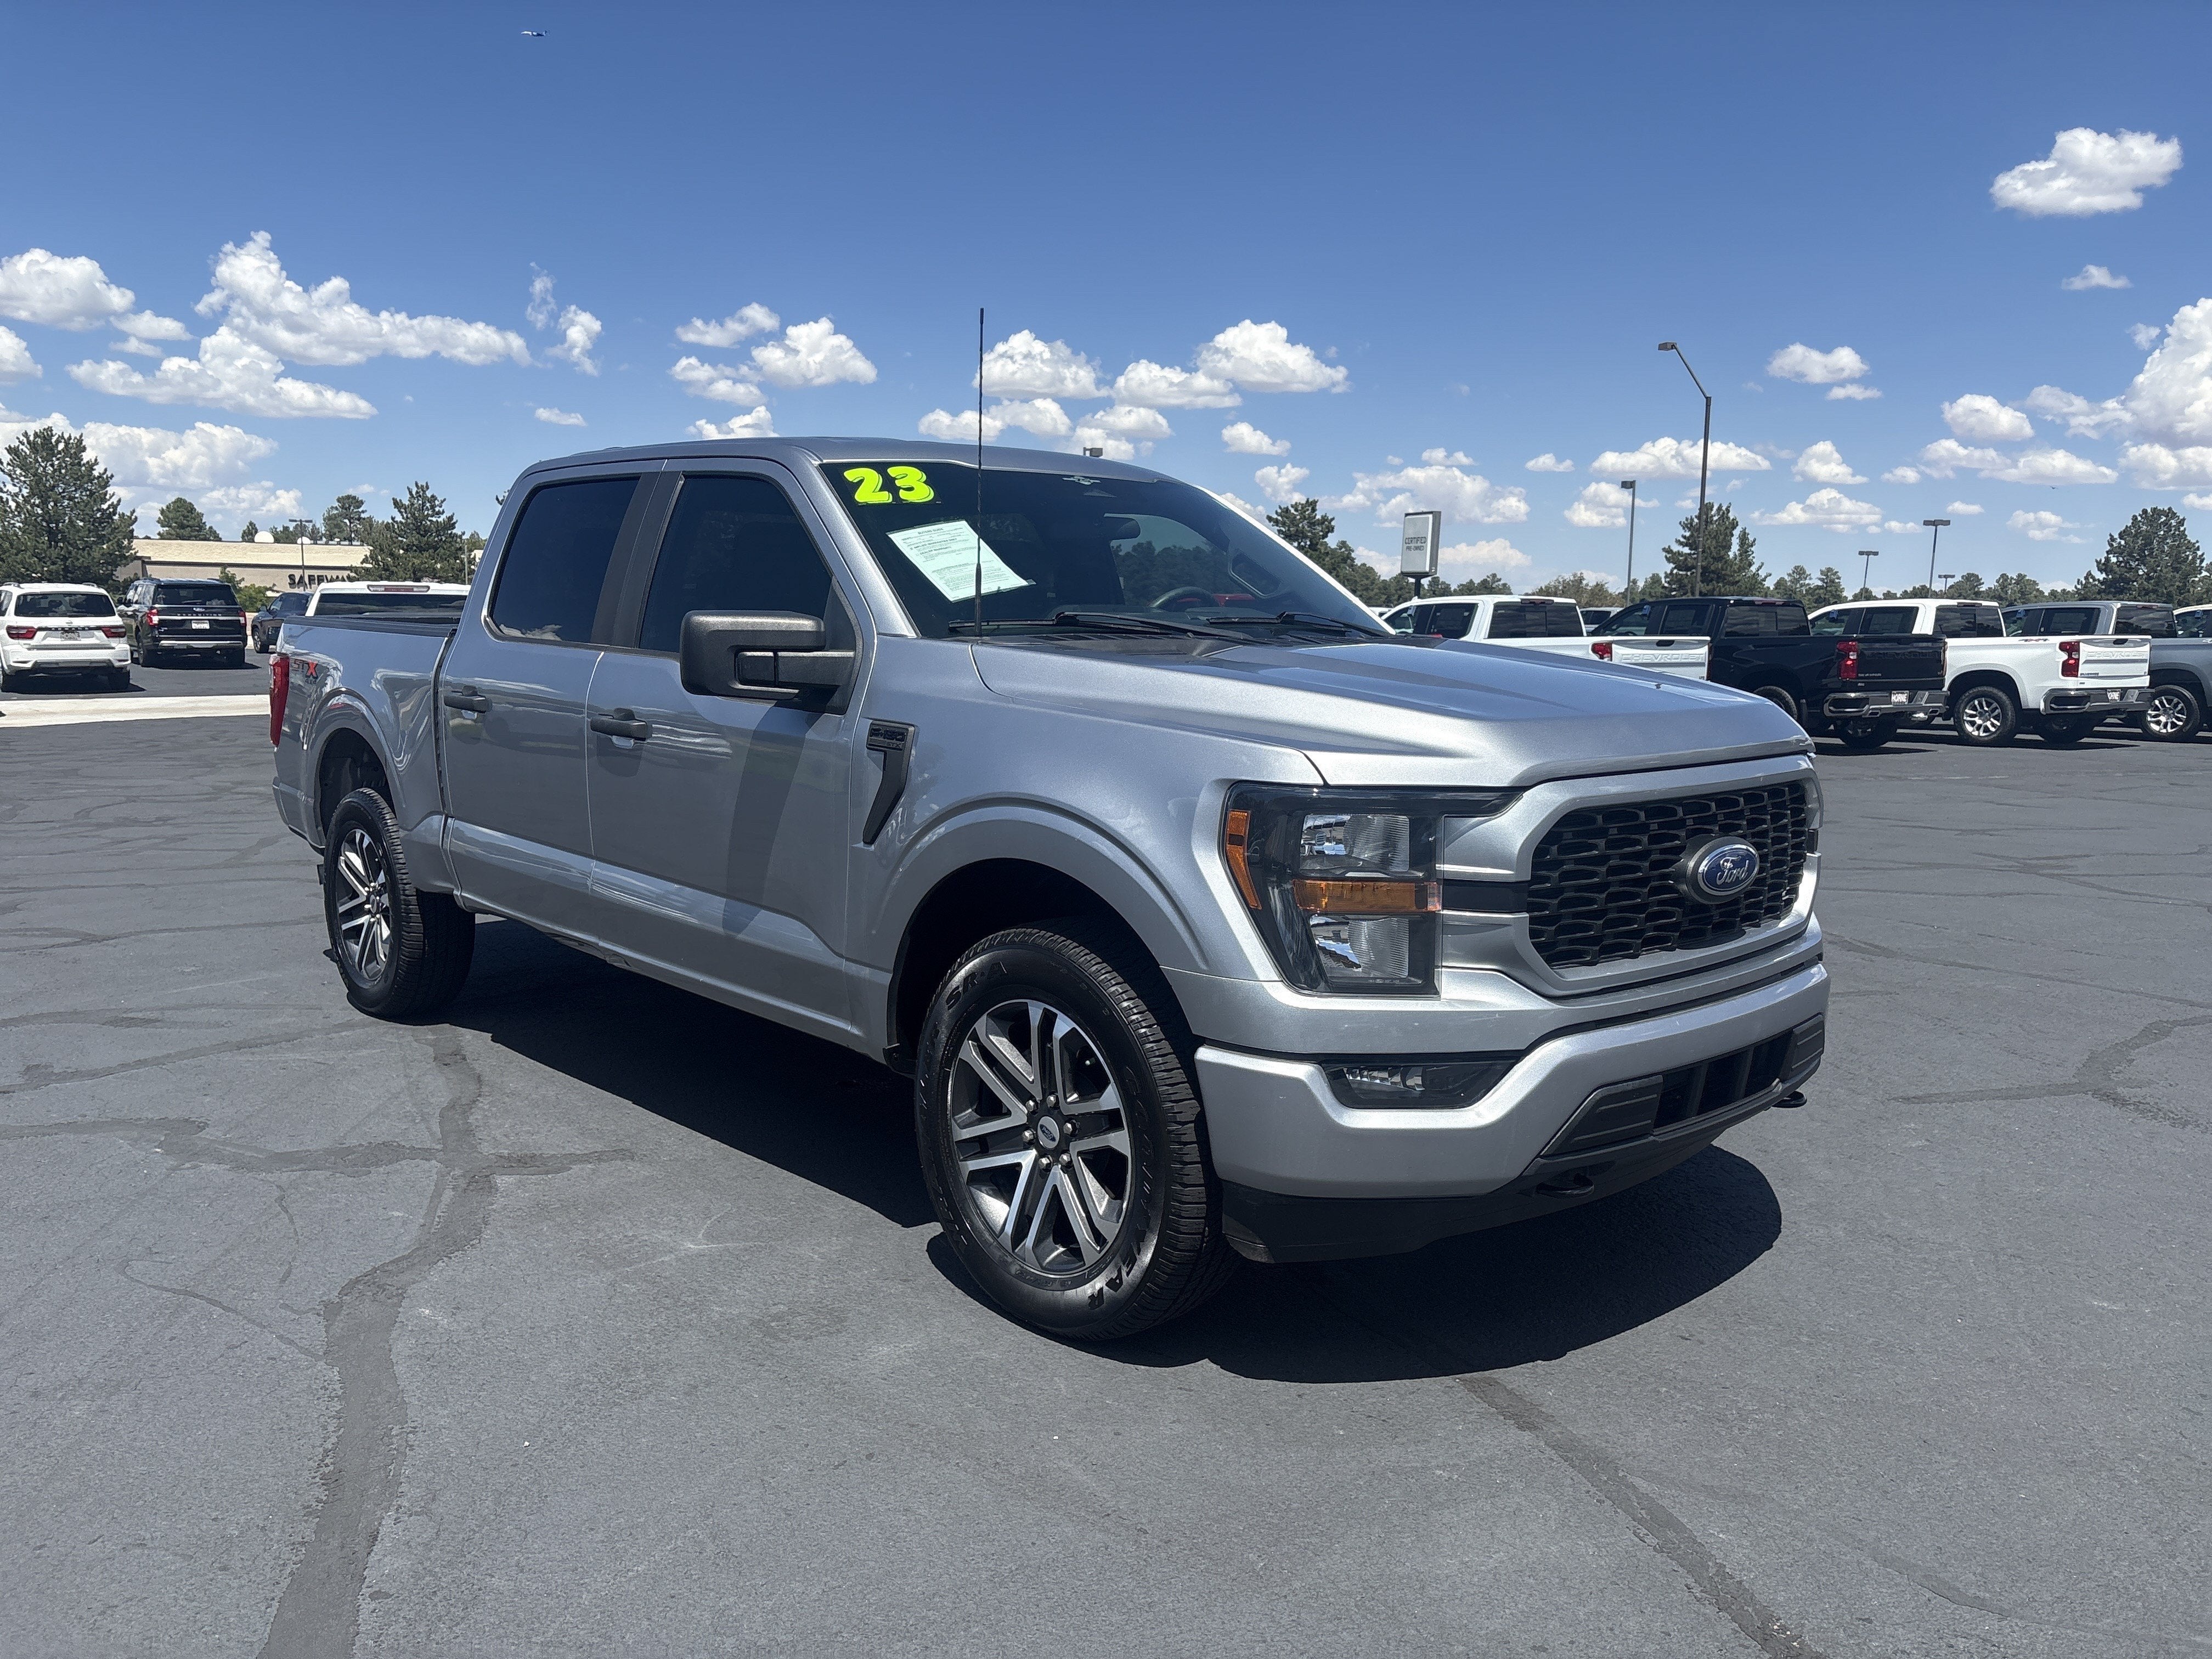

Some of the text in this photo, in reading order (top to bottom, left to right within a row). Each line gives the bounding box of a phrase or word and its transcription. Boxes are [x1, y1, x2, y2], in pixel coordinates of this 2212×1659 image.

[844, 466, 934, 504] 23
[1621, 653, 1705, 662] CHEVROLET
[1892, 693, 1908, 702] HORNE
[1716, 855, 1750, 885] Ford
